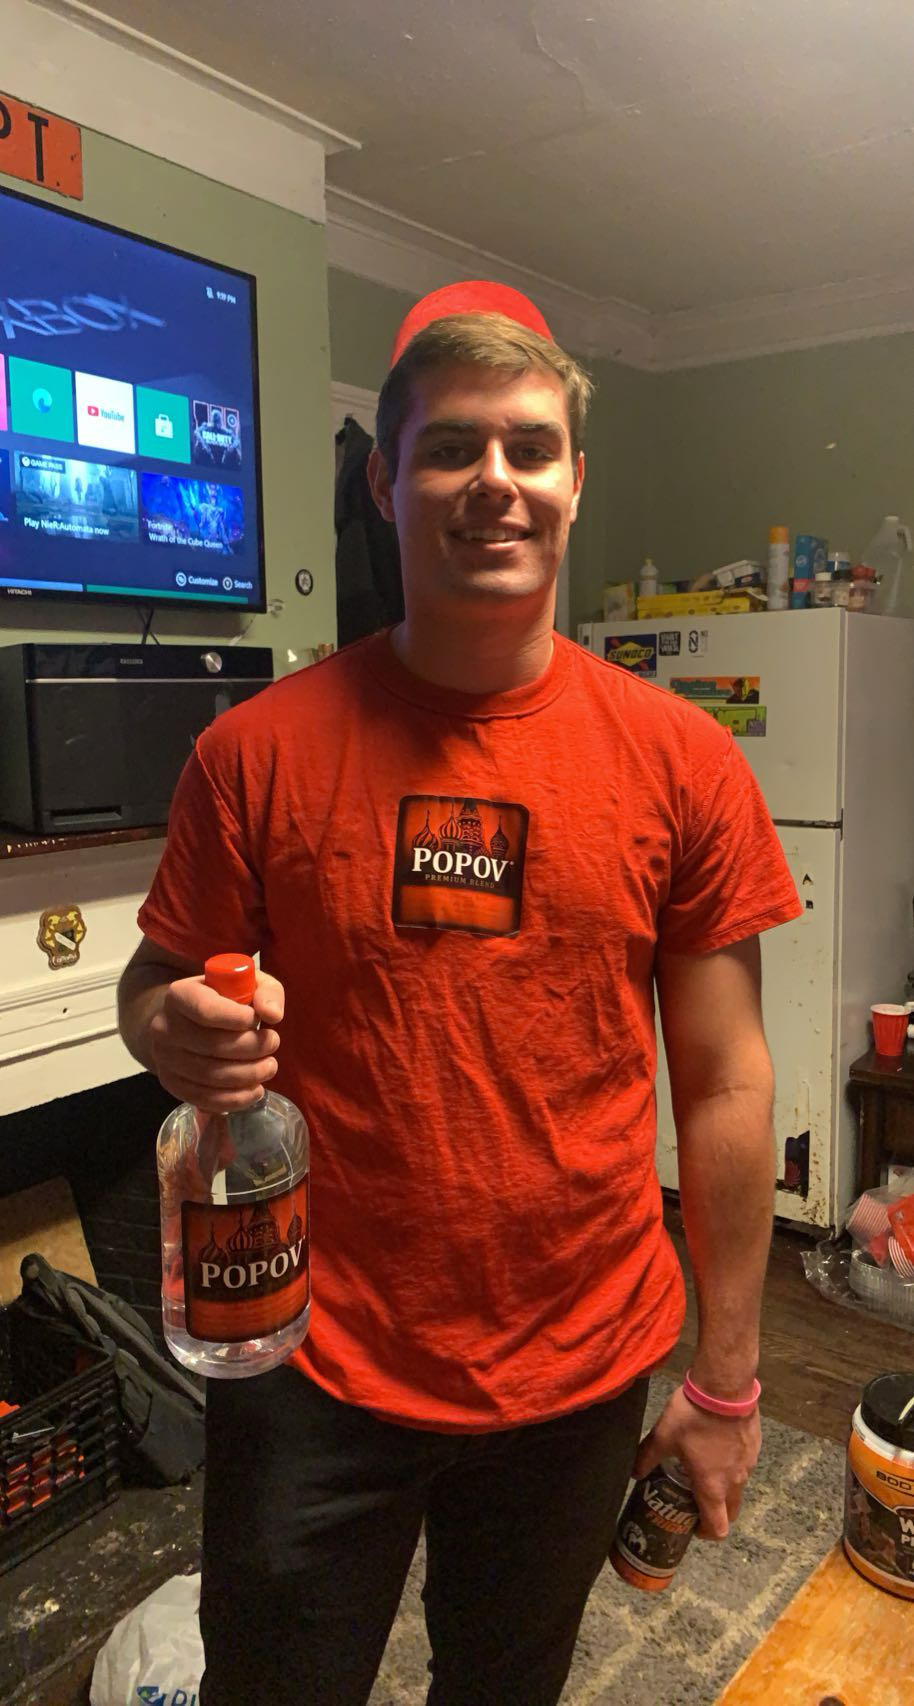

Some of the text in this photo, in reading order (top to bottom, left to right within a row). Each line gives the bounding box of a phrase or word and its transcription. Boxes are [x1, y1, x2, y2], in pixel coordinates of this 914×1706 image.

[100, 409, 125, 422] YouTube
[24, 517, 39, 529] Play
[94, 527, 109, 535] now
[148, 532, 168, 542] Wrath
[176, 536, 187, 545] the
[187, 537, 203, 547] Cube
[204, 540, 223, 549] Queen
[188, 575, 219, 587] Customize
[234, 580, 253, 590] Search
[609, 648, 653, 661] SUNOCO
[411, 847, 510, 882] POPOV
[425, 873, 495, 889] PREMIUM BLEND
[201, 1238, 304, 1289] POPOV
